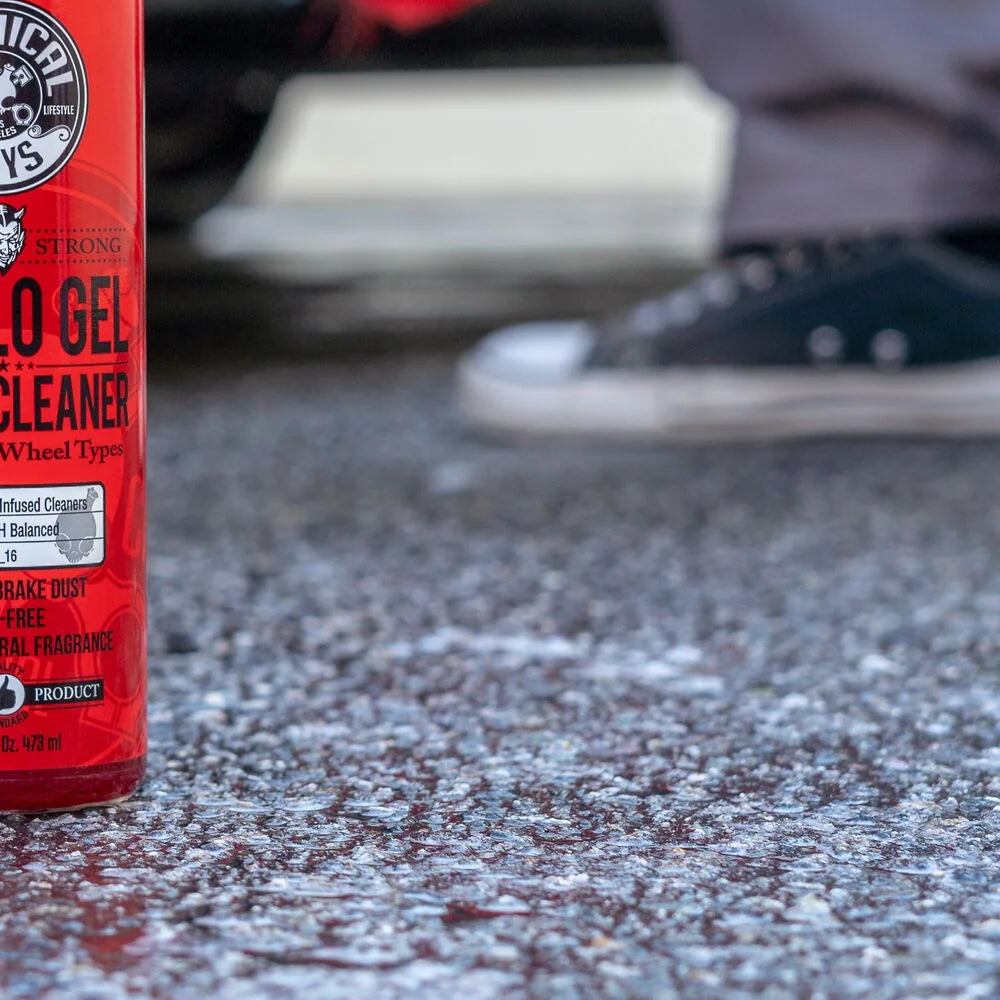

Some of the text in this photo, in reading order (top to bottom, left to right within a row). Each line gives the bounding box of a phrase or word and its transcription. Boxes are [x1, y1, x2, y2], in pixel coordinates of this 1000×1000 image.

[43, 105, 74, 115] LIFESTYLE
[36, 237, 122, 255] STRONG
[59, 275, 129, 356] GEL
[74, 440, 123, 464] Types
[0, 497, 41, 513] Infused
[44, 495, 88, 512] Cleaners
[10, 522, 60, 538] Balanced
[51, 577, 88, 598] DUST
[34, 631, 114, 656] FRAGRANCE
[34, 683, 100, 701] PRODUCT
[23, 734, 44, 751] 473
[47, 733, 61, 750] ml
